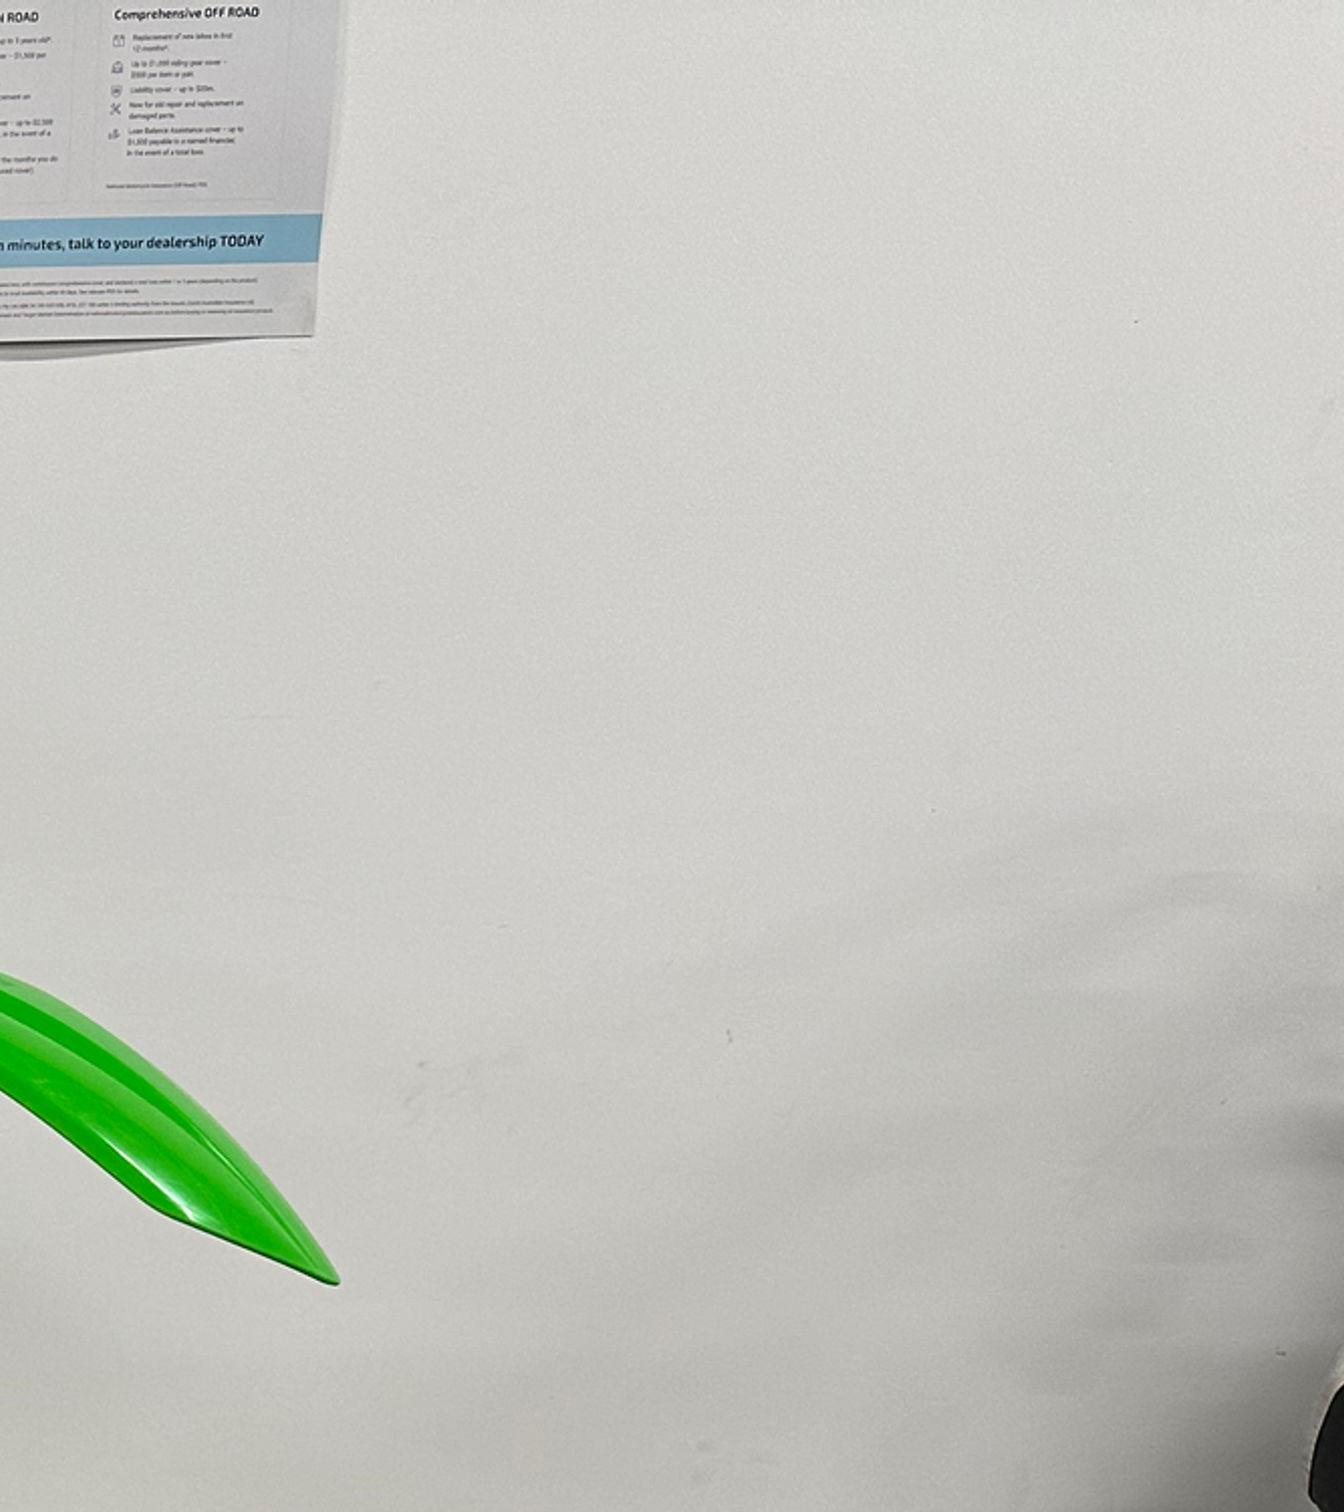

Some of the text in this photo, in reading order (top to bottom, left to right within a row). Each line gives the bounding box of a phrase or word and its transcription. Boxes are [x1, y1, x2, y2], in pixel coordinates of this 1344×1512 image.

[8, 12, 39, 23] ROAD
[114, 7, 259, 21] Comprehensive OFF ROAD
[7, 239, 64, 252] minutes,
[68, 238, 94, 250] talk
[97, 238, 111, 249] to
[114, 239, 143, 252] your
[146, 235, 216, 249] dealership
[220, 235, 264, 247] TODAY
